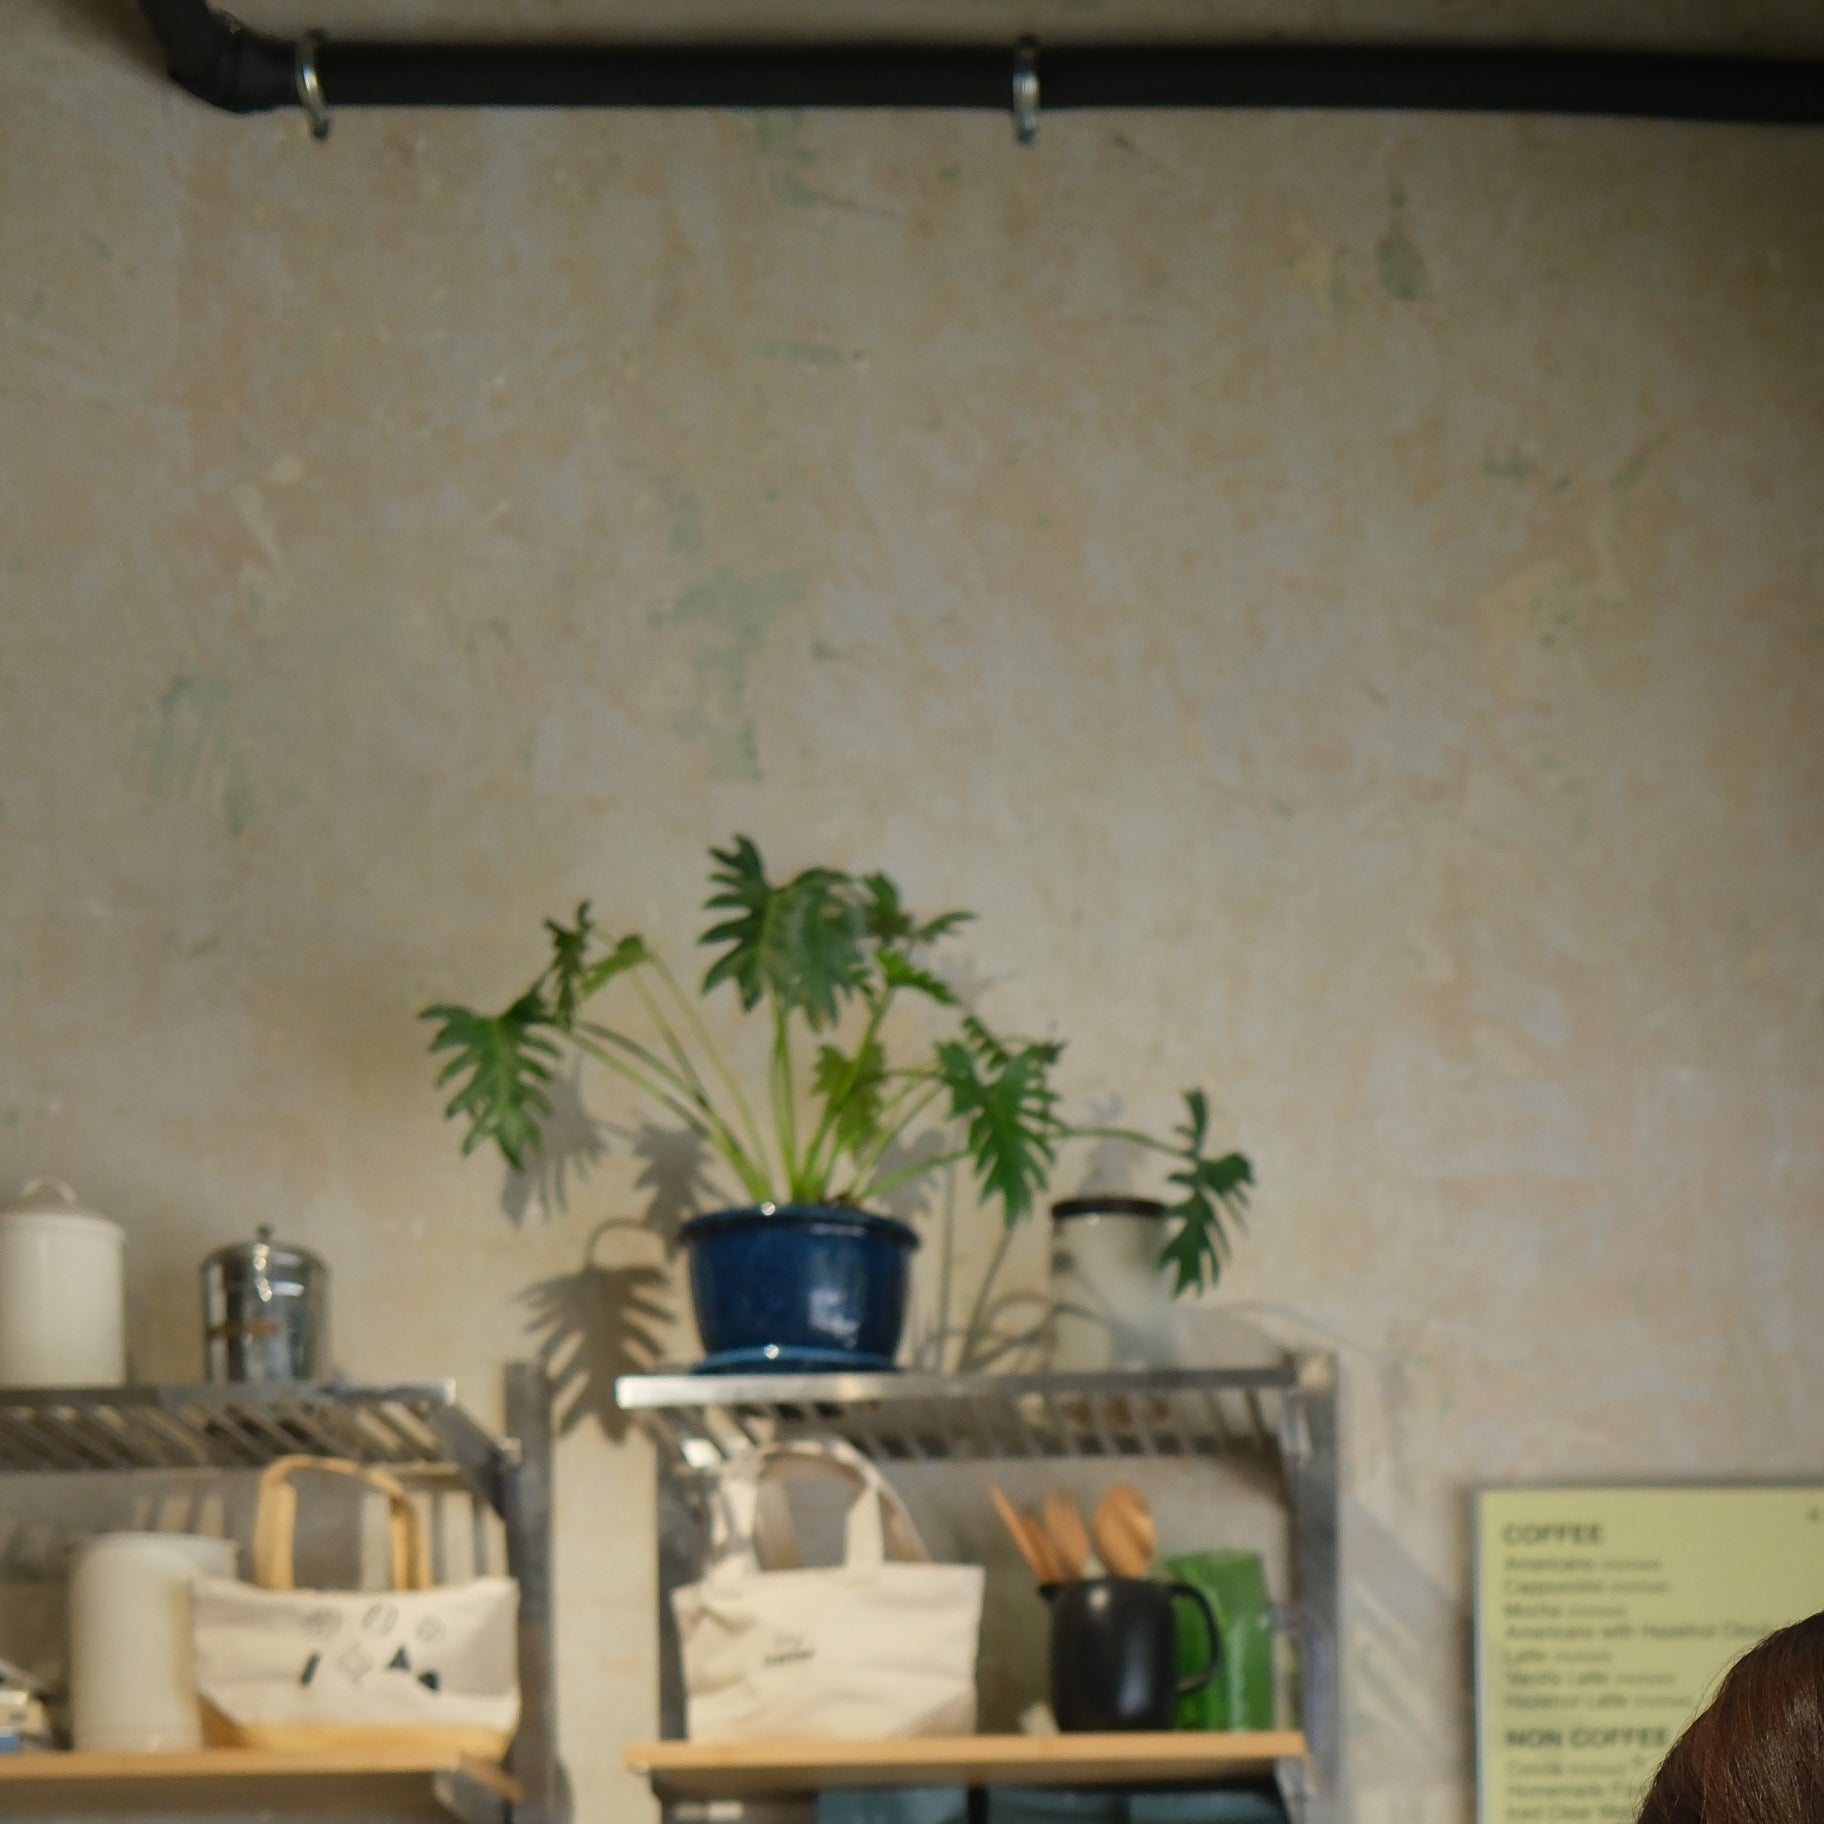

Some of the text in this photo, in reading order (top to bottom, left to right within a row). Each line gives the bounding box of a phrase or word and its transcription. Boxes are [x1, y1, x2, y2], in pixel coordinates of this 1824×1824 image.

[1502, 1522, 1602, 1544] COFFEE
[1507, 1728, 1667, 1748] NON COFFEE
